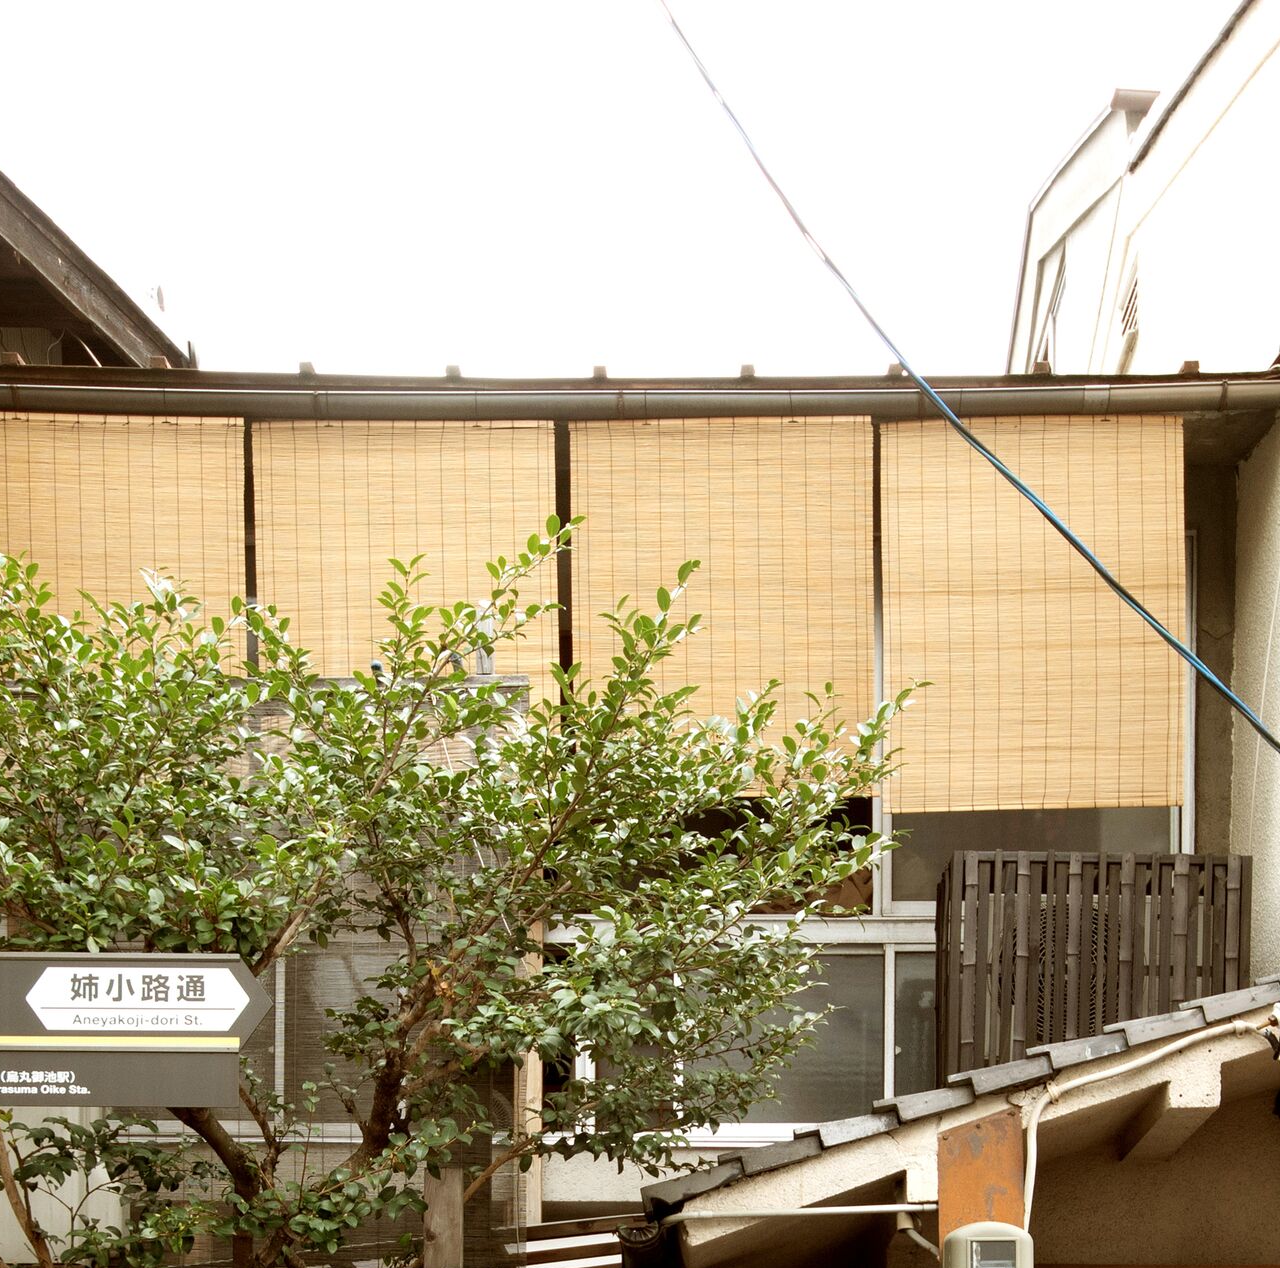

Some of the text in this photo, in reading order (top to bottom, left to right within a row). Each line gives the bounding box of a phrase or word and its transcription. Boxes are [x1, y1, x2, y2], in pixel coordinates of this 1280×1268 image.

[70, 973, 206, 1002] 姉小路通
[72, 1014, 203, 1028] Aneyakoji-dori St.
[40, 1084, 67, 1095] Oike
[68, 1084, 90, 1095] Sta.
